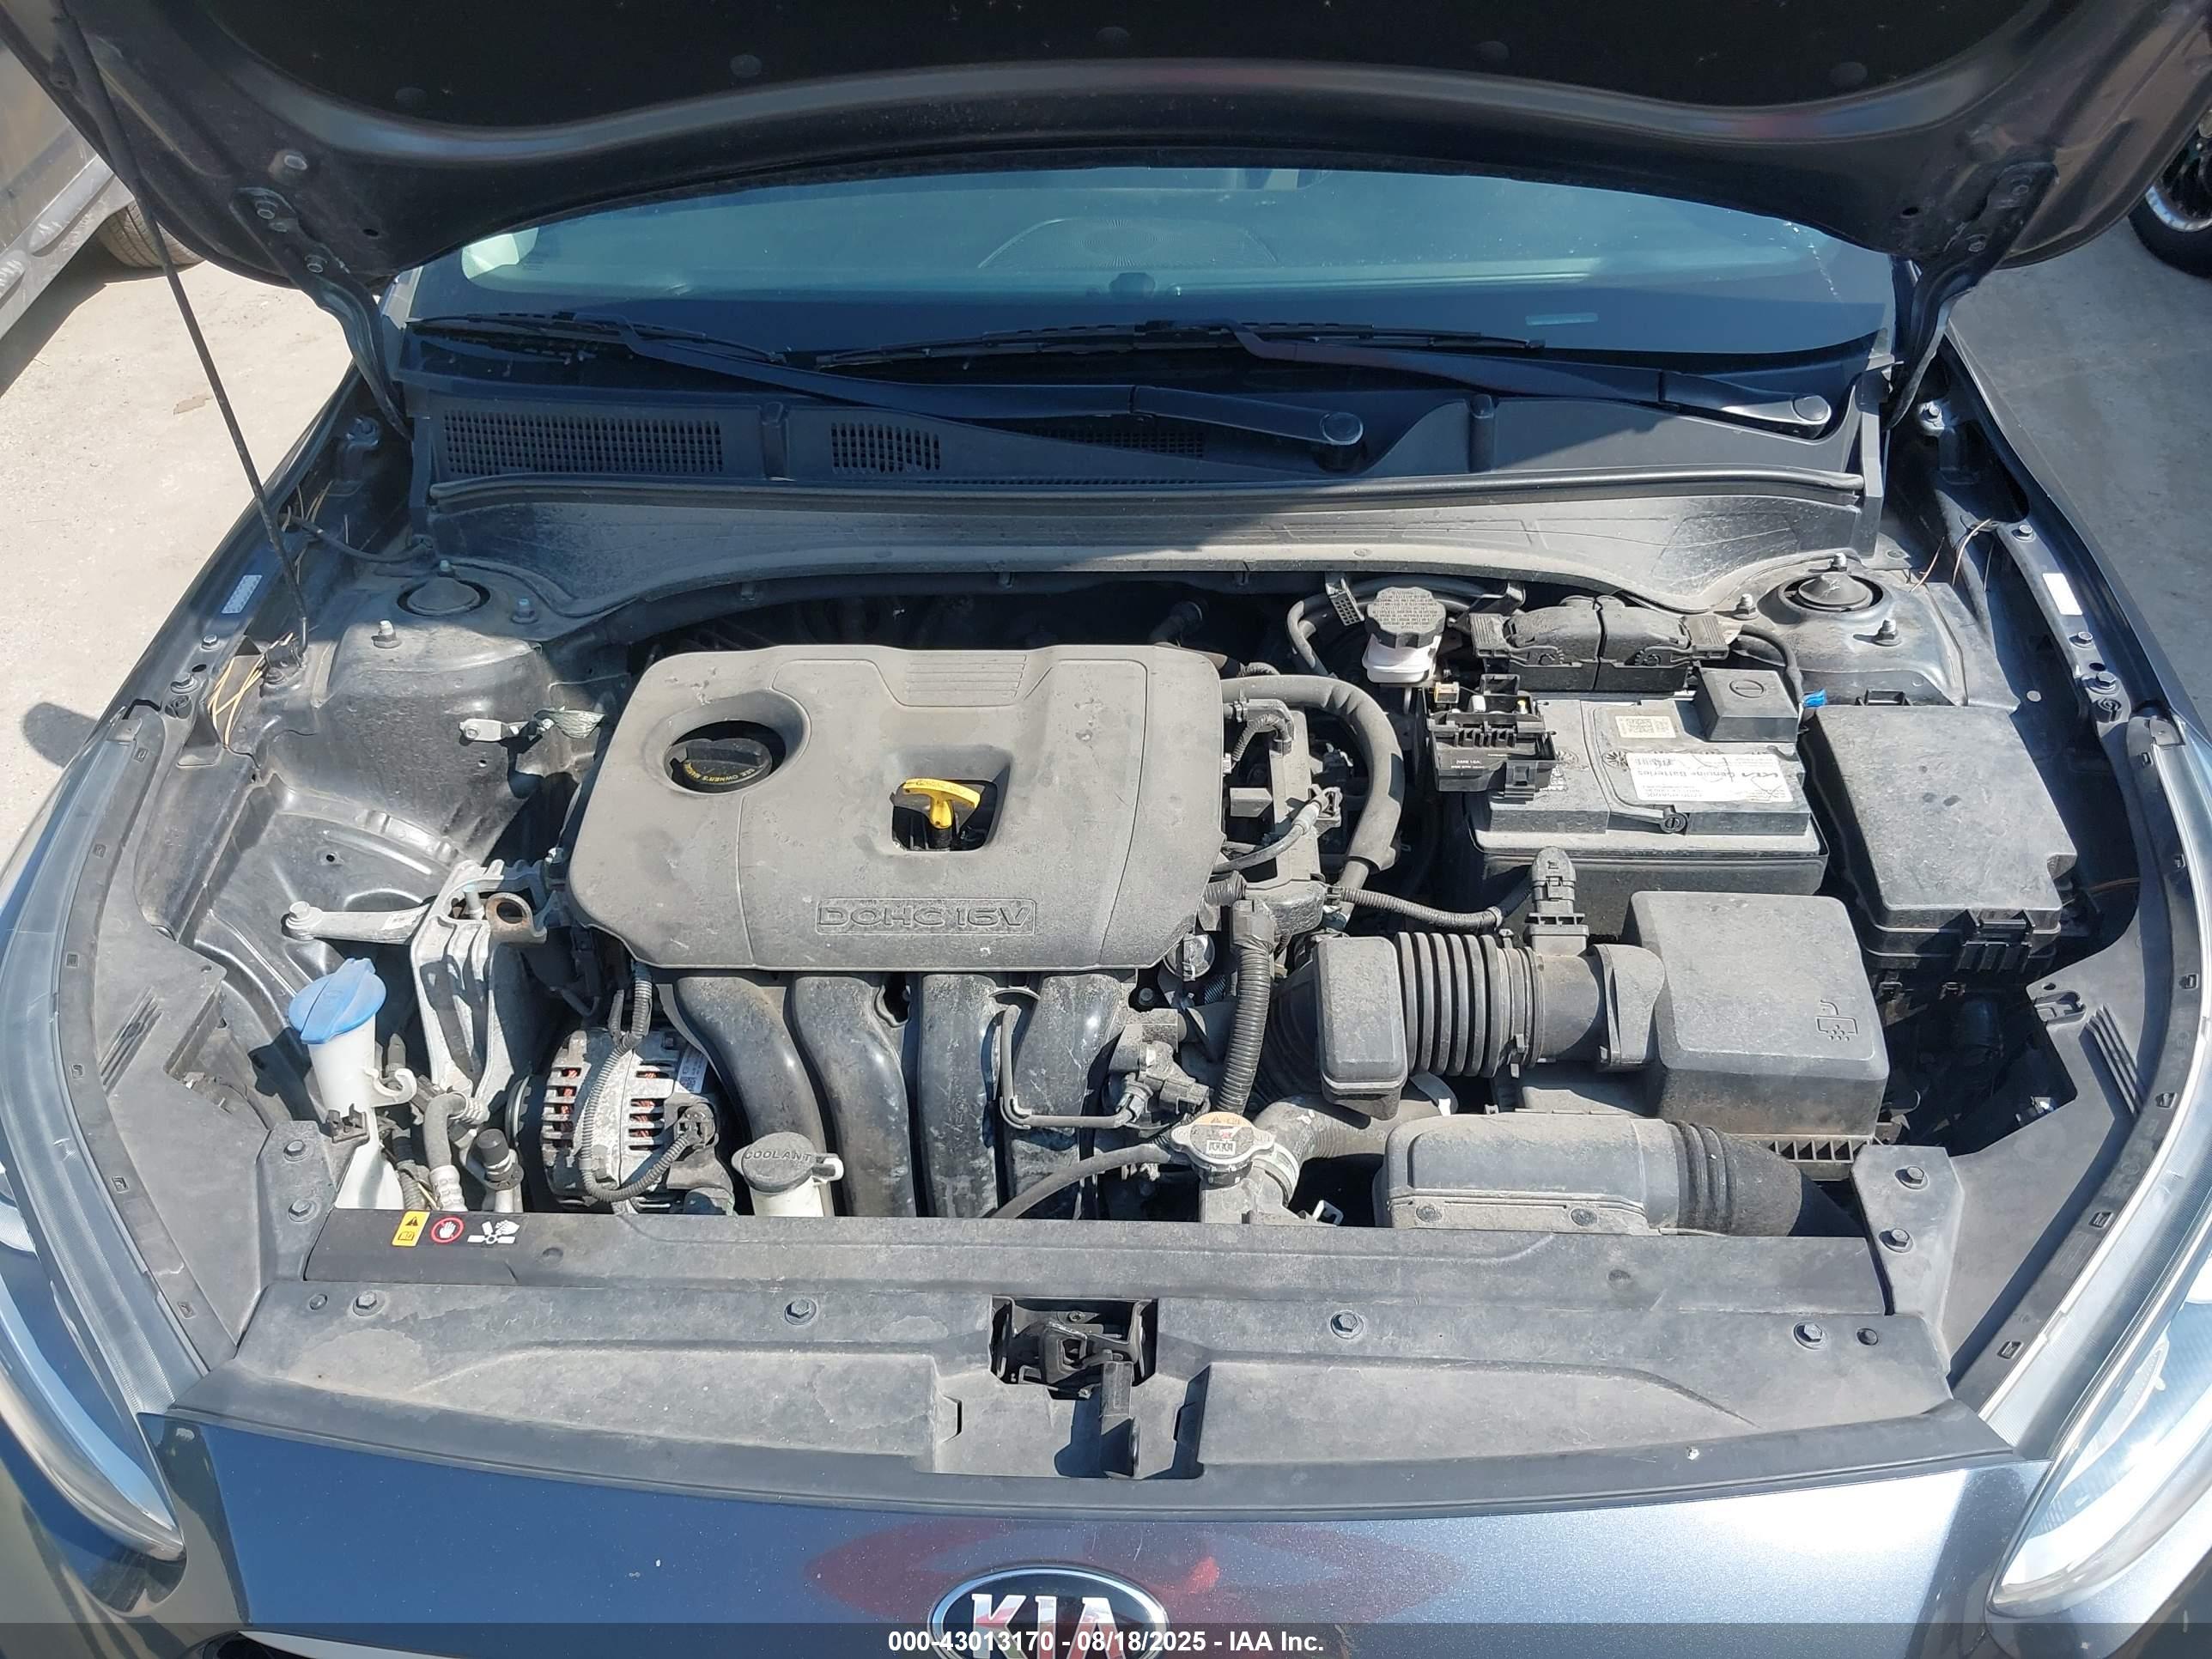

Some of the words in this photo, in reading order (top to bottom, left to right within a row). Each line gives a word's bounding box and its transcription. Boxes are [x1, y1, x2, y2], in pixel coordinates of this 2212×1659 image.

[702, 775, 739, 783] OWNER'S
[817, 906, 945, 927] DOHC
[956, 906, 1031, 927] 16V
[744, 1150, 812, 1163] COOLANT
[971, 1593, 1127, 1659] KIA
